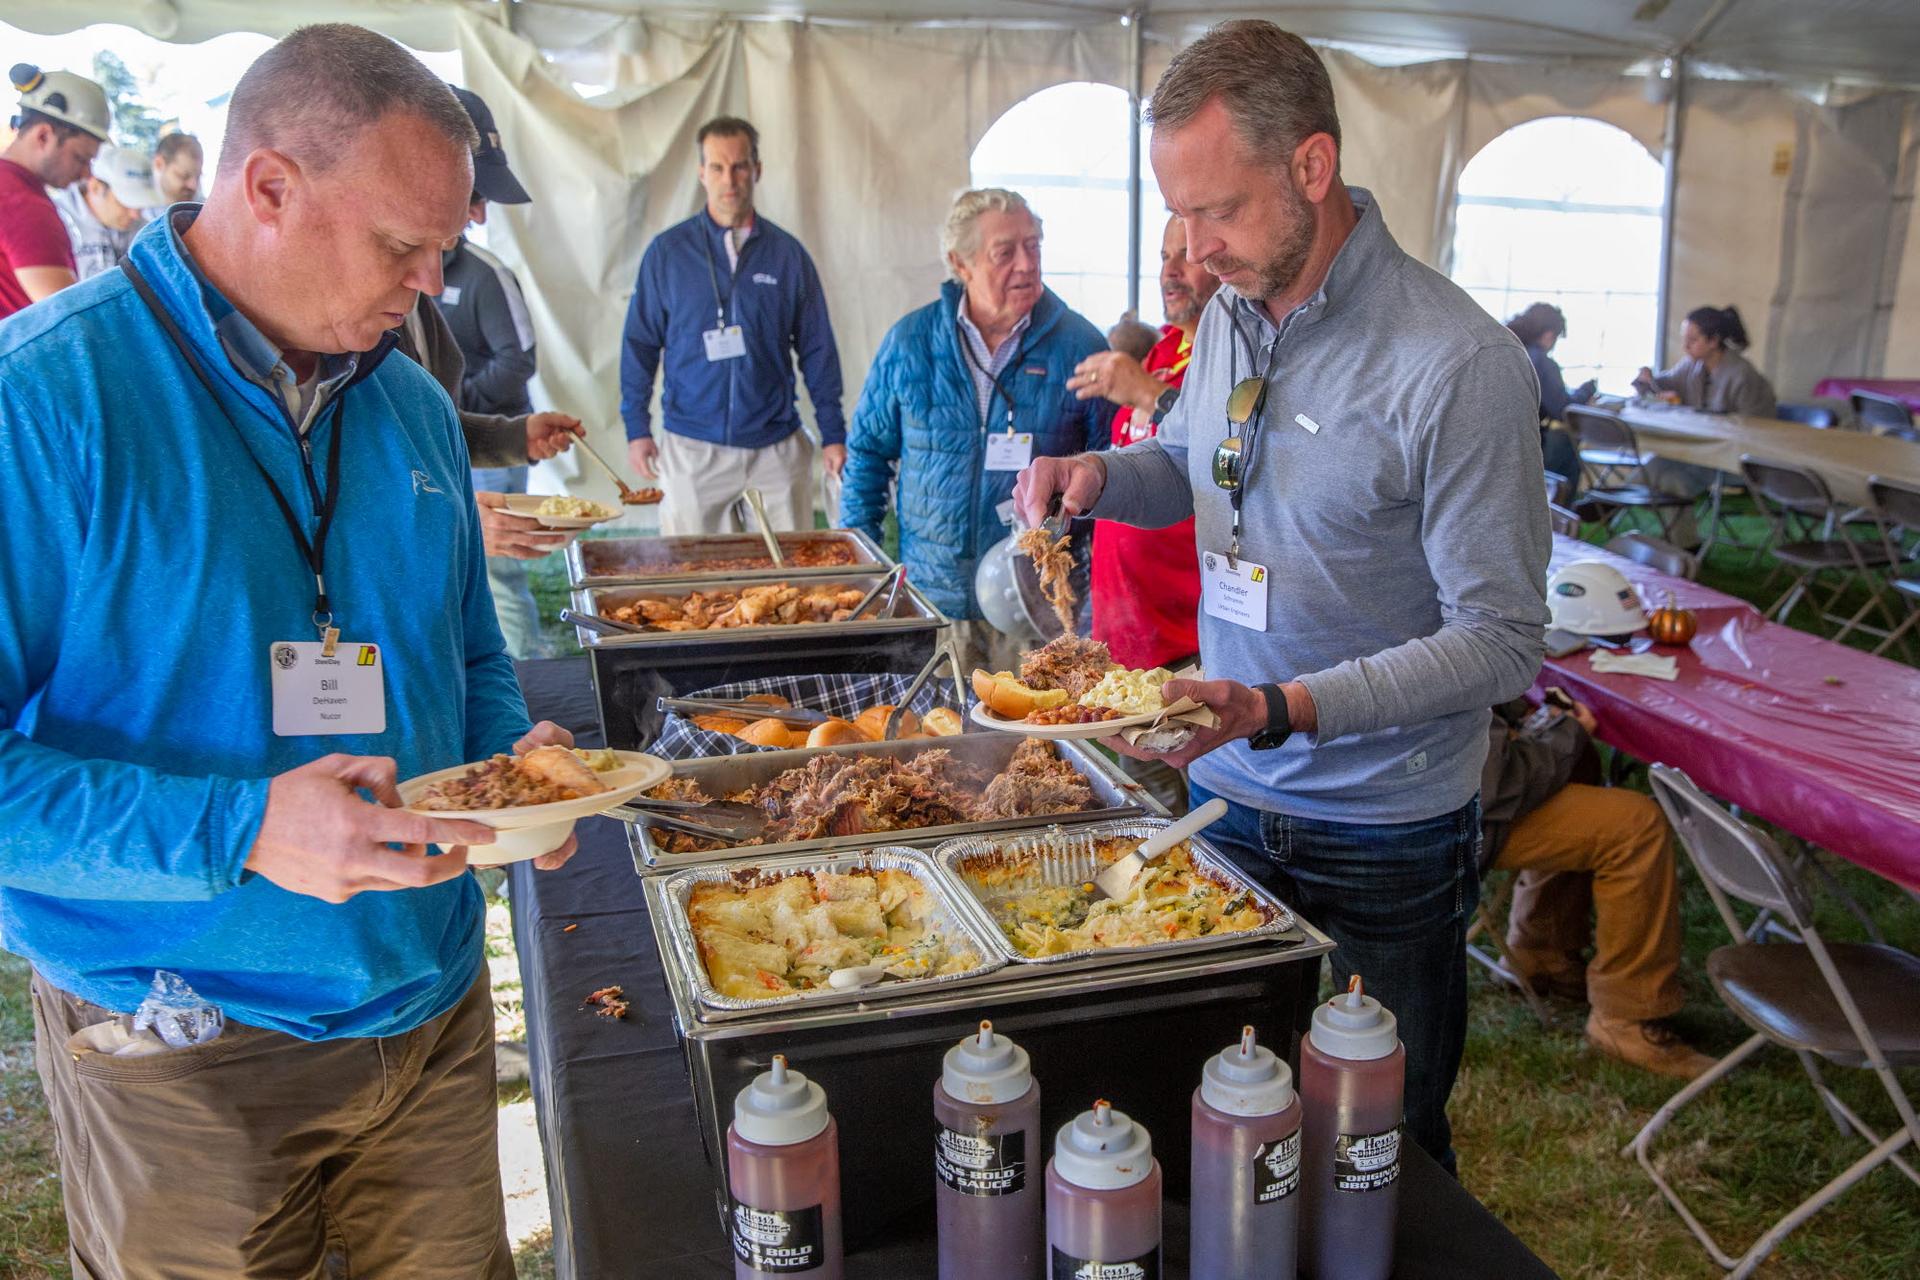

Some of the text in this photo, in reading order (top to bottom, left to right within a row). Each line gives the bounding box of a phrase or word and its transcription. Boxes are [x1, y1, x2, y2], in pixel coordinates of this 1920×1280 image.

[1219, 580, 1248, 597] Chandler
[1217, 603, 1230, 611] Urban
[320, 679, 338, 691] Bill
[312, 697, 347, 705] DeHaven
[949, 1131, 979, 1148] Hess's
[1364, 1134, 1394, 1149] Hess's
[970, 1169, 1014, 1180] BOLD
[957, 1176, 1012, 1189] SAUCE
[1339, 1181, 1370, 1189] BBQ
[1259, 1187, 1288, 1201] BBQ
[766, 1245, 812, 1257] BOLD
[753, 1254, 809, 1267] SAUCE
[1092, 1264, 1130, 1277] Hess's
